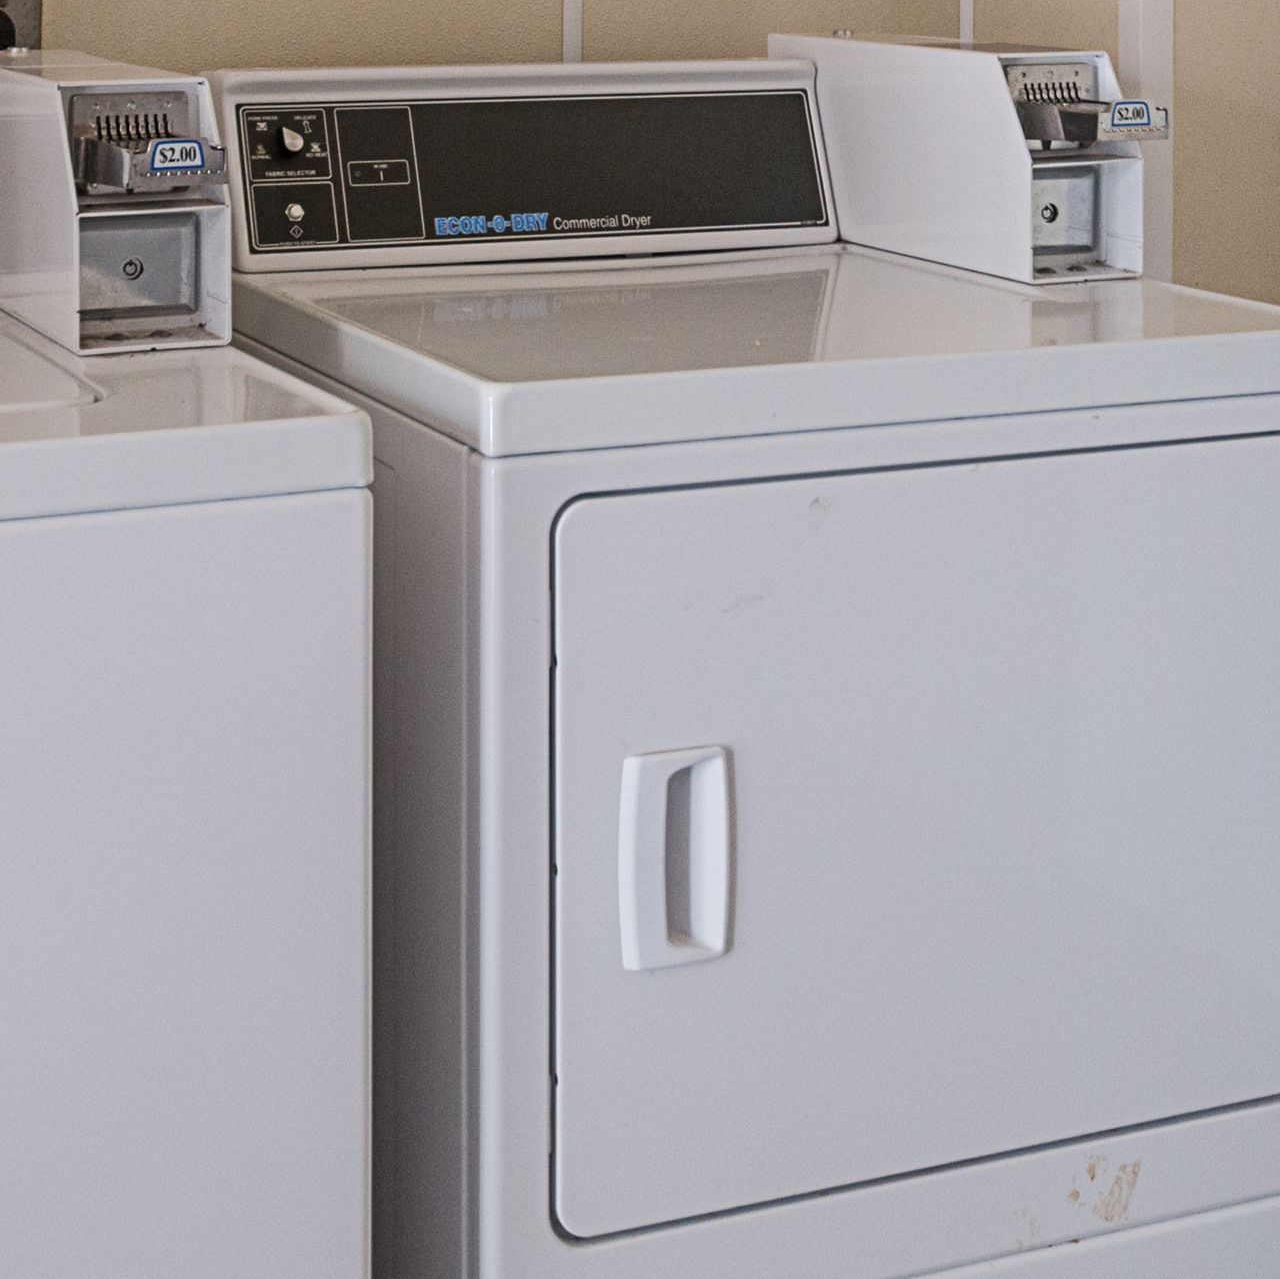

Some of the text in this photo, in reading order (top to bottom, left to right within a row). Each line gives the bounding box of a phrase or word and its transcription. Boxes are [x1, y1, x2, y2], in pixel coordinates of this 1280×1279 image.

[1116, 106, 1145, 121] $2.00
[158, 146, 197, 164] $2.00
[553, 215, 619, 230] Commercial
[621, 214, 652, 228] Dryer
